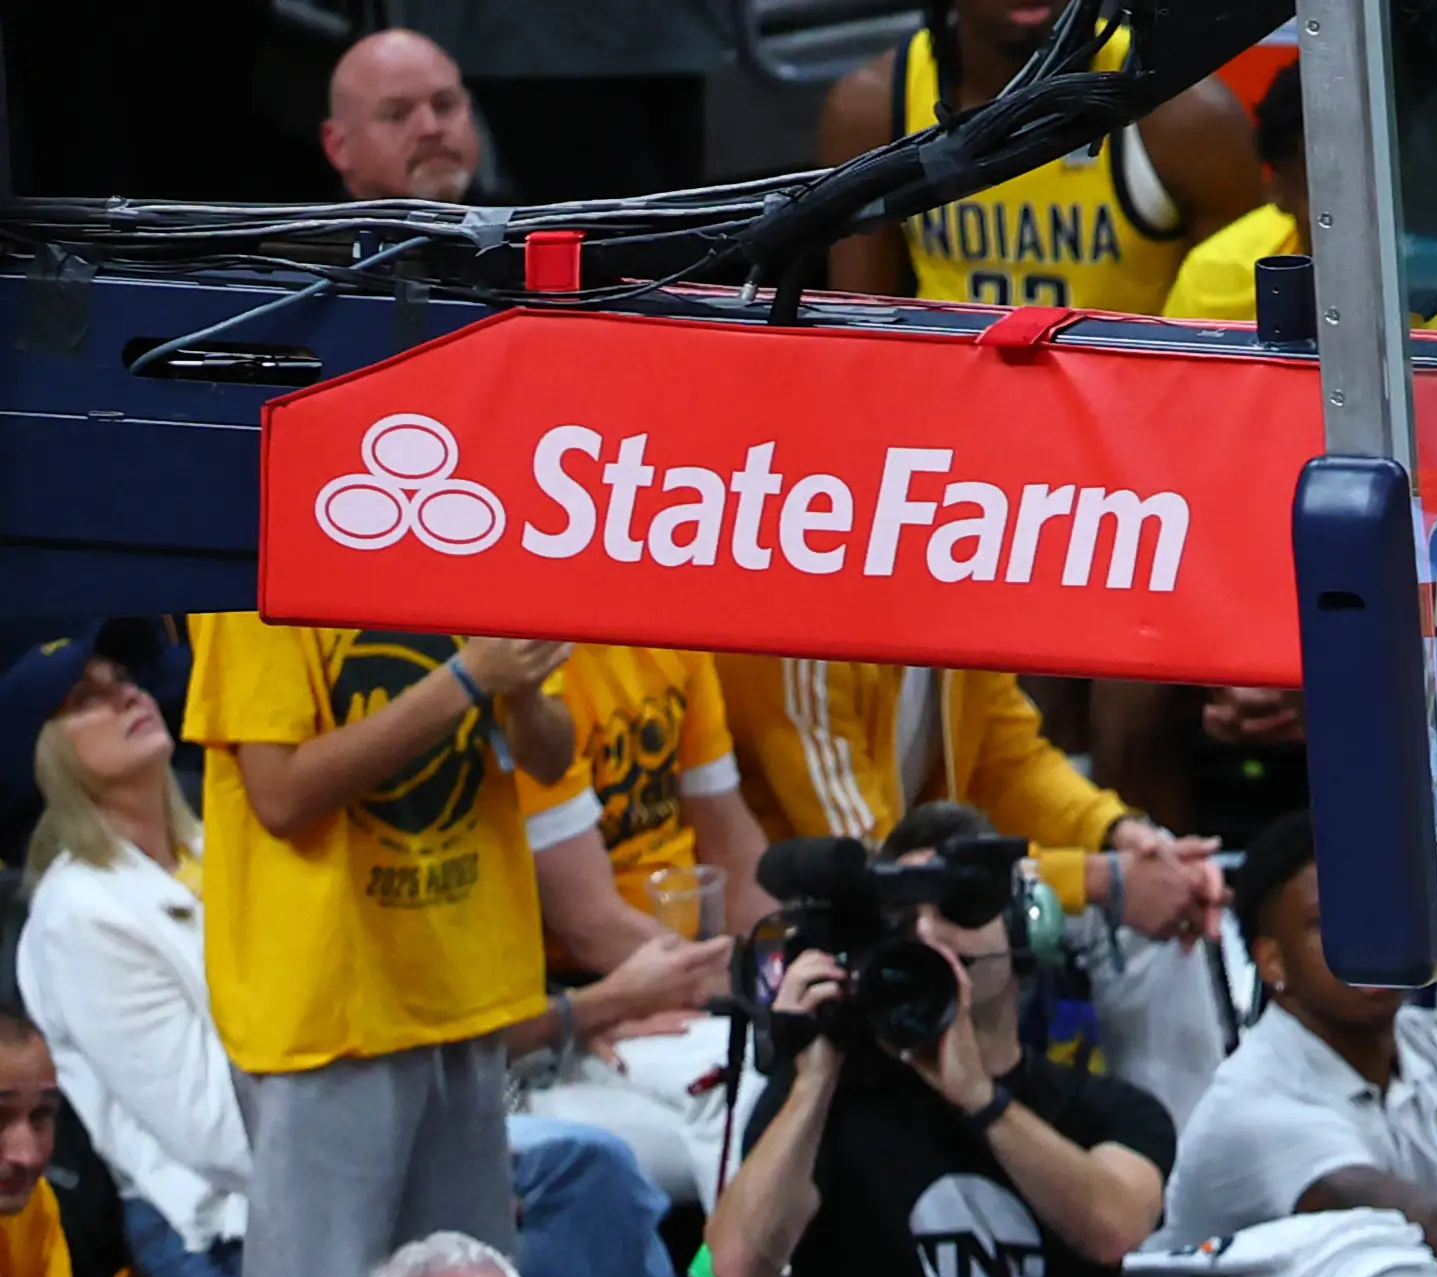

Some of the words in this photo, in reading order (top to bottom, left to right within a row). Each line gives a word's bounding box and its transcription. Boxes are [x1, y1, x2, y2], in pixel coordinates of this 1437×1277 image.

[918, 202, 1124, 264] NDIANA
[521, 424, 854, 575] State
[862, 446, 1191, 592] Farm
